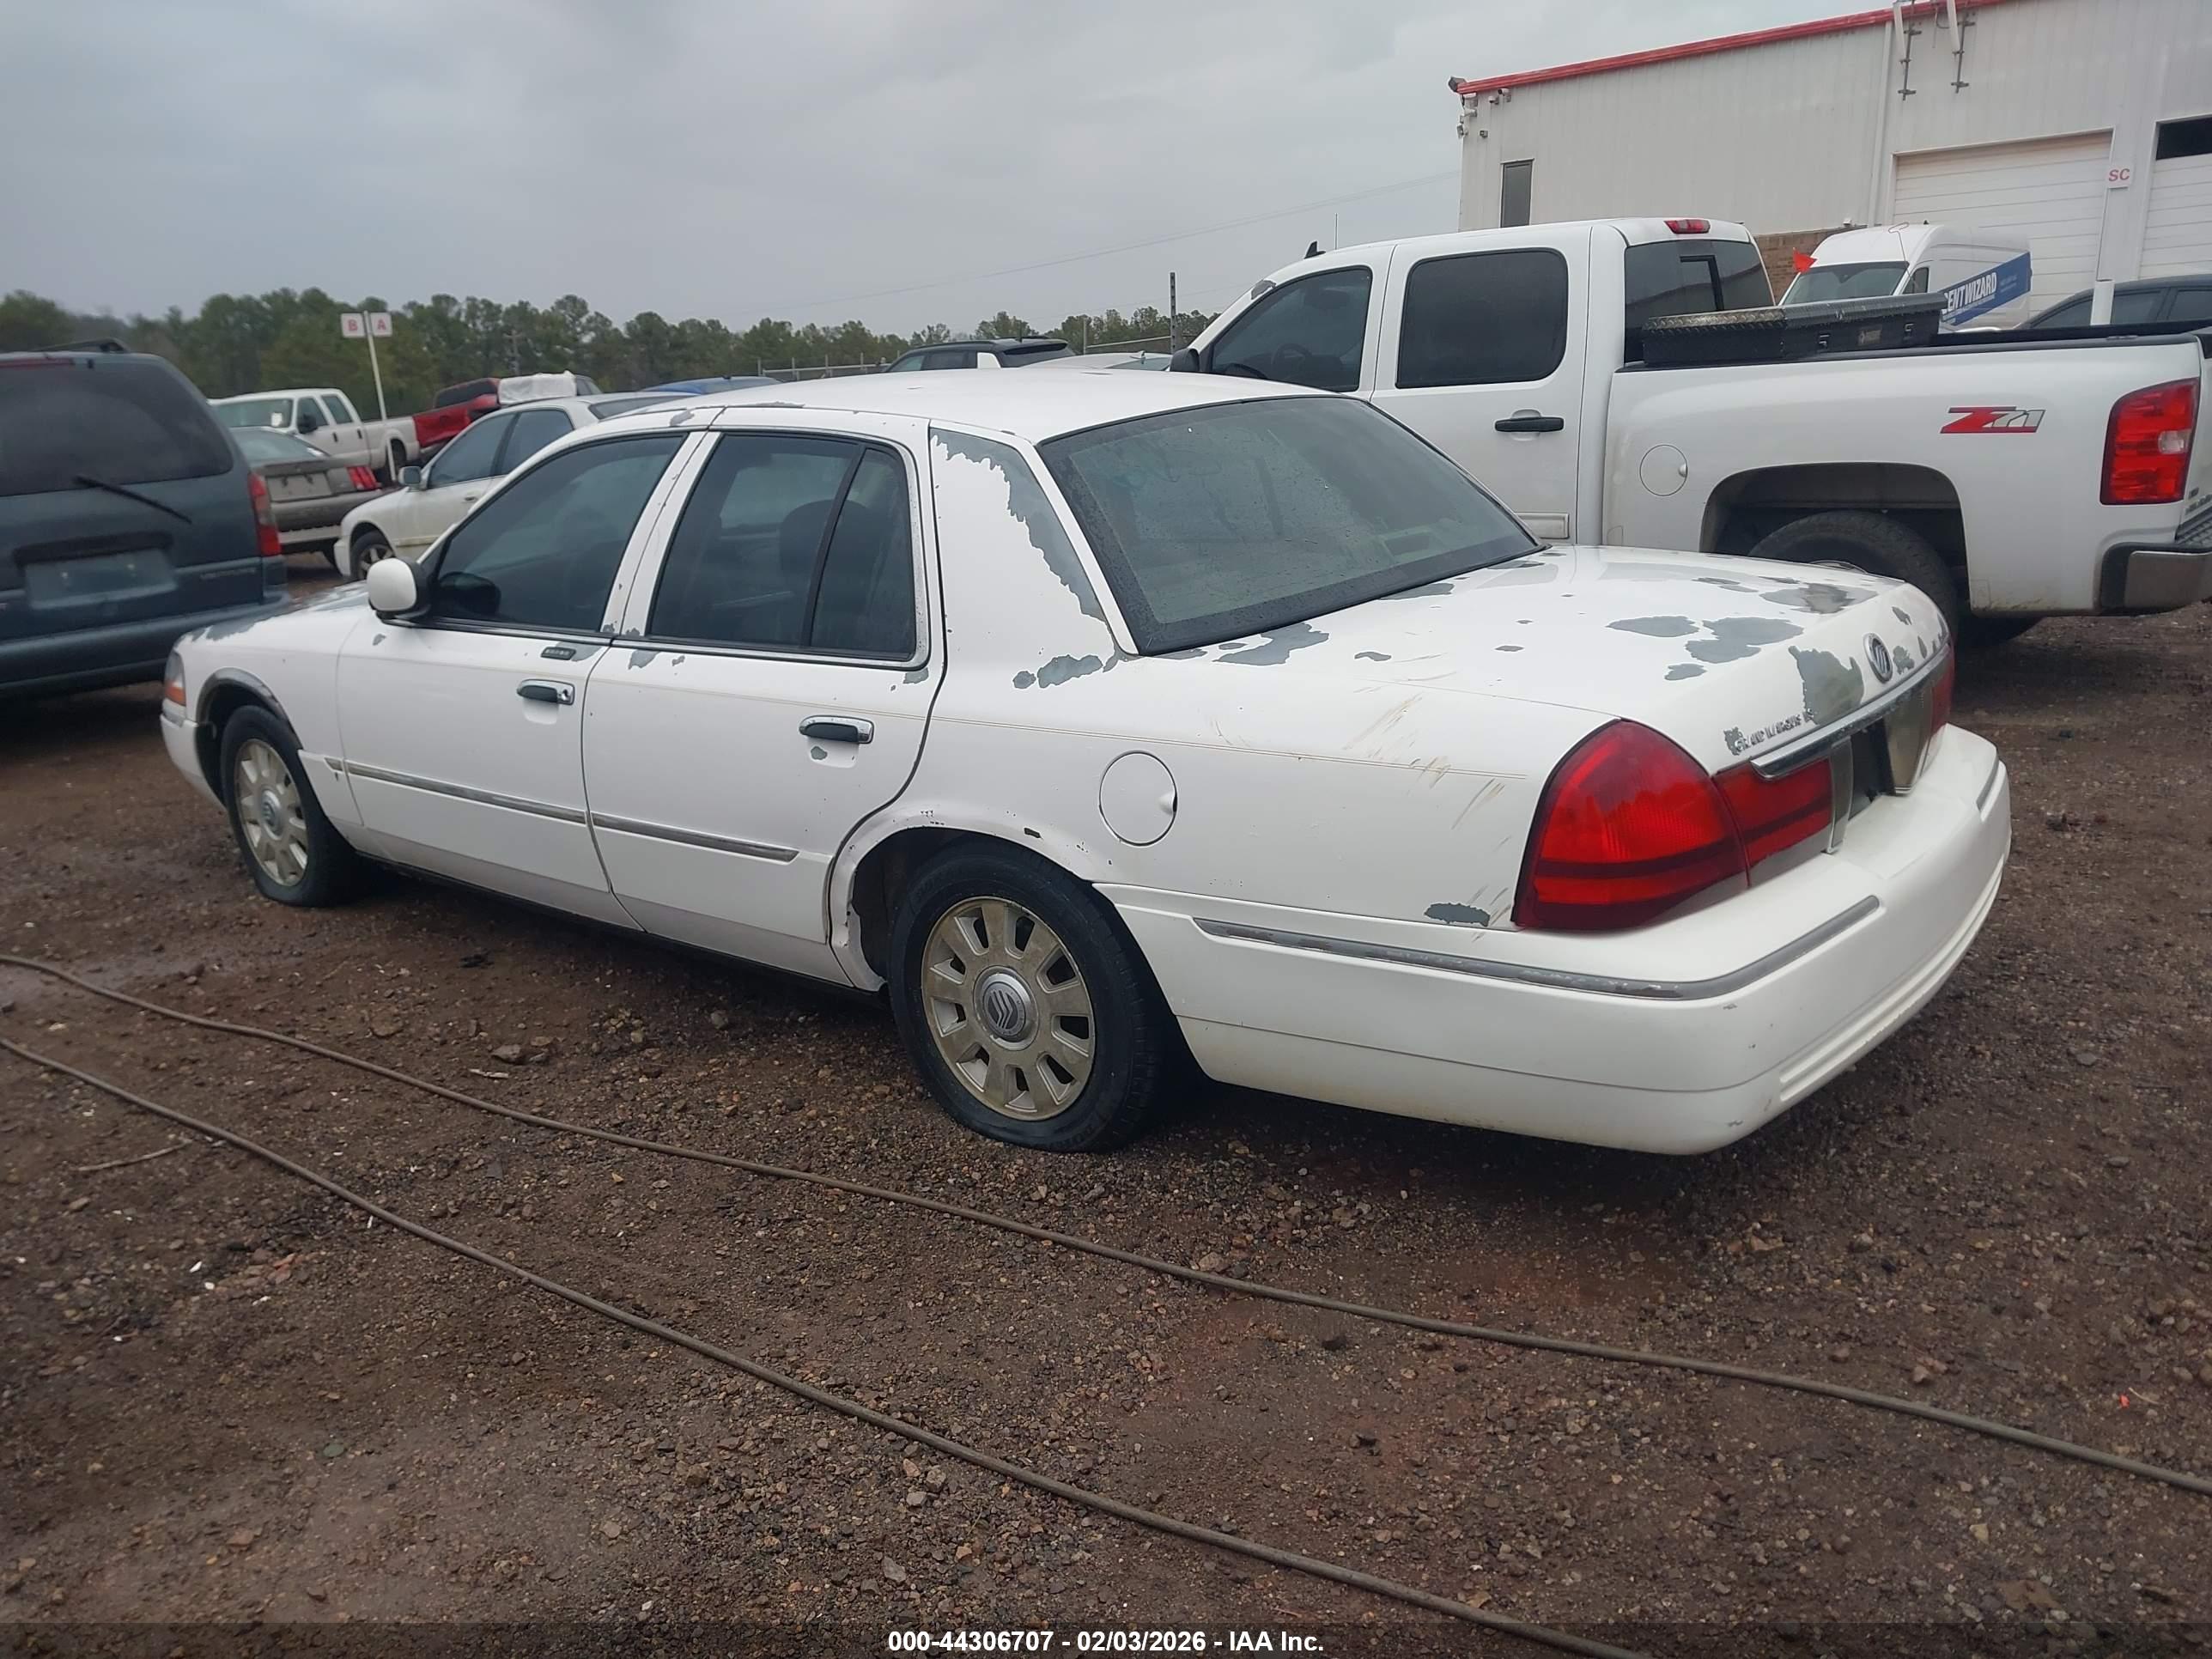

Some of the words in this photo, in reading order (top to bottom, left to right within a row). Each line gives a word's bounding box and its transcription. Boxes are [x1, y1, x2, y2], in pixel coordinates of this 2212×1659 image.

[2108, 168, 2130, 182] SC
[348, 319, 358, 331] B
[377, 319, 386, 331] A
[1940, 405, 2045, 434] Z71
